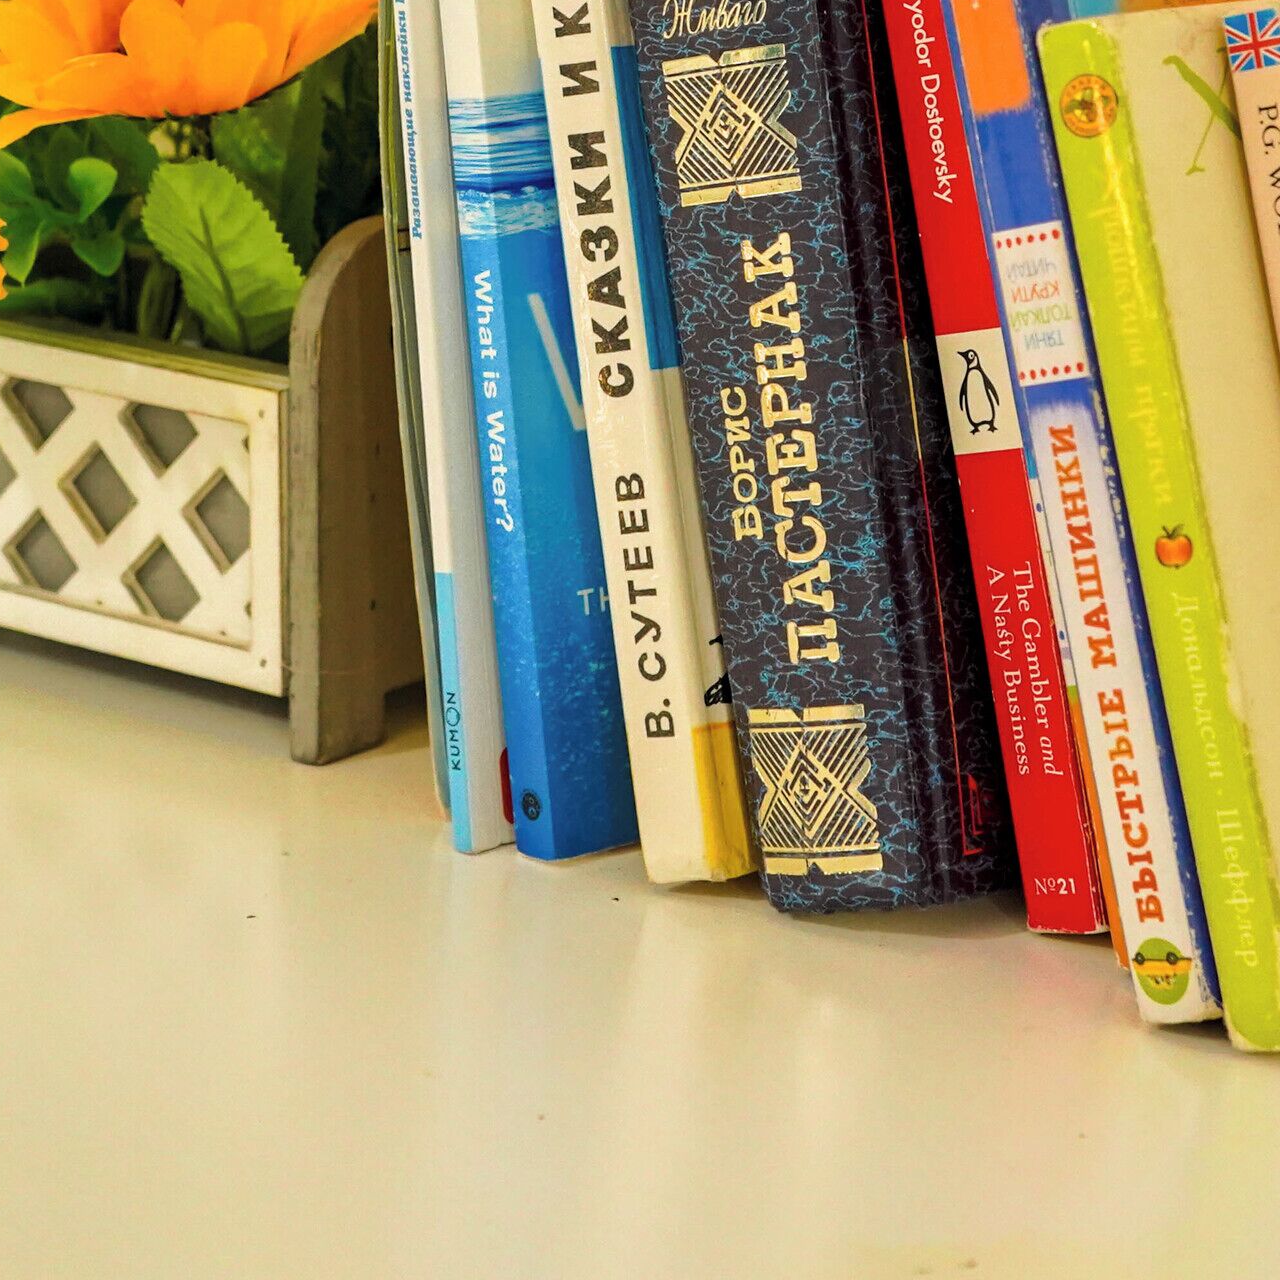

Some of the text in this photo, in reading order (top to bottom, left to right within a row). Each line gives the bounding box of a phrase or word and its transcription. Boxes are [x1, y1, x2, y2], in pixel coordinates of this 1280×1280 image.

[399, 9, 414, 103] наклейки
[560, 62, 601, 97] И
[921, 73, 958, 204] Dostoevsky
[404, 106, 423, 240] Развивающие
[570, 131, 635, 397] СКАЗКИ
[1011, 280, 1060, 304] КРУТИ
[473, 268, 514, 533] What is Water?
[720, 385, 765, 540] БОРИС
[742, 231, 840, 666] ПАСТЕРНАК
[616, 471, 675, 740] В. СУТЕЕВ
[986, 565, 1030, 777] A Nasty Business
[1013, 561, 1064, 778] The Gambler and
[1050, 425, 1165, 923] БЫСТРЫЕ МАШИНКИ
[447, 690, 463, 772] KUMON
[1172, 591, 1258, 967] Дональдсон Шеффлер
